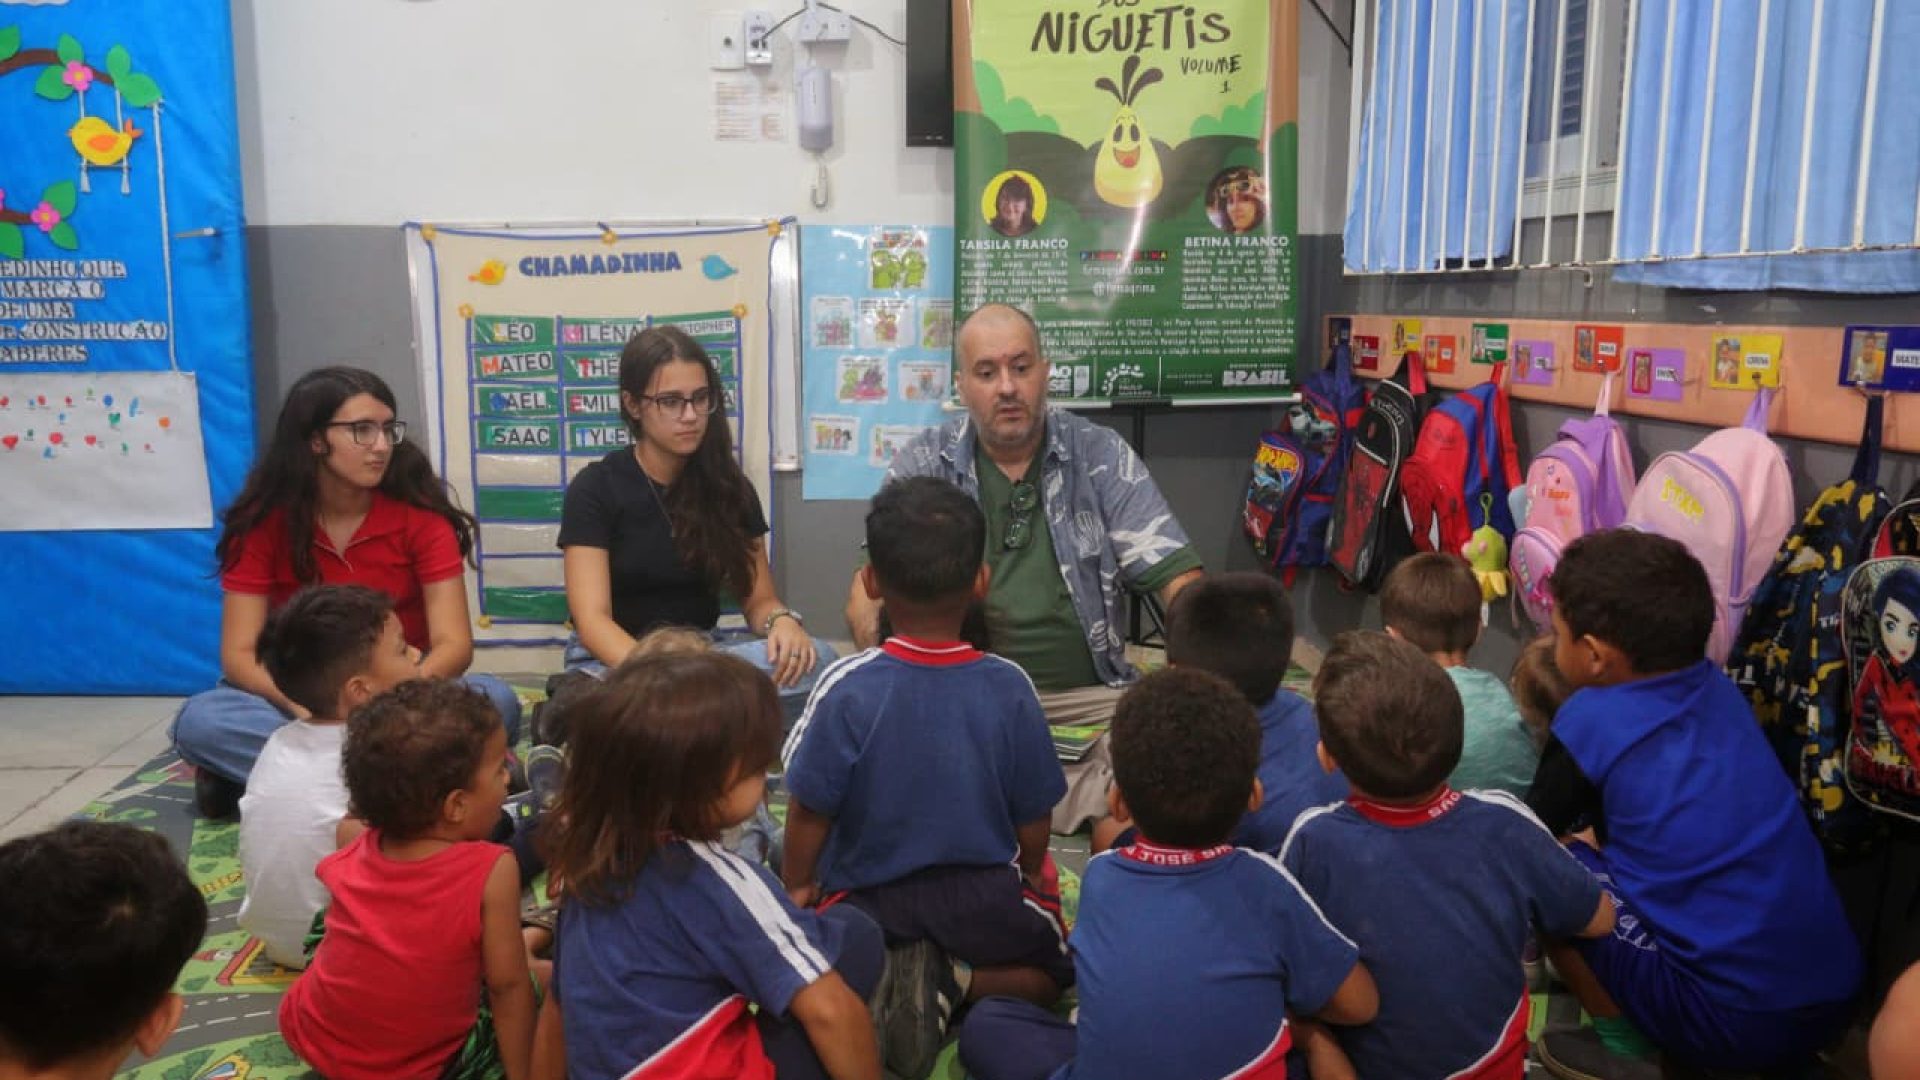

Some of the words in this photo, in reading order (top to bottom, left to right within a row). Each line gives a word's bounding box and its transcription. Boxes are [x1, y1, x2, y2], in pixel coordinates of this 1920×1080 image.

[1180, 54, 1242, 75] VOLUME
[1015, 238, 1068, 250] FRANCO
[1185, 236, 1231, 248] BETINA
[1235, 236, 1289, 248] FRANCO
[81, 260, 126, 277] QUE
[519, 251, 682, 276] CHAMADINHA
[26, 301, 73, 318] UMA
[480, 352, 551, 375] MATEO
[1223, 369, 1290, 387] BRASIL
[569, 394, 620, 412] EMIL
[486, 427, 549, 444] ISAAC
[576, 427, 628, 446] TYLE
